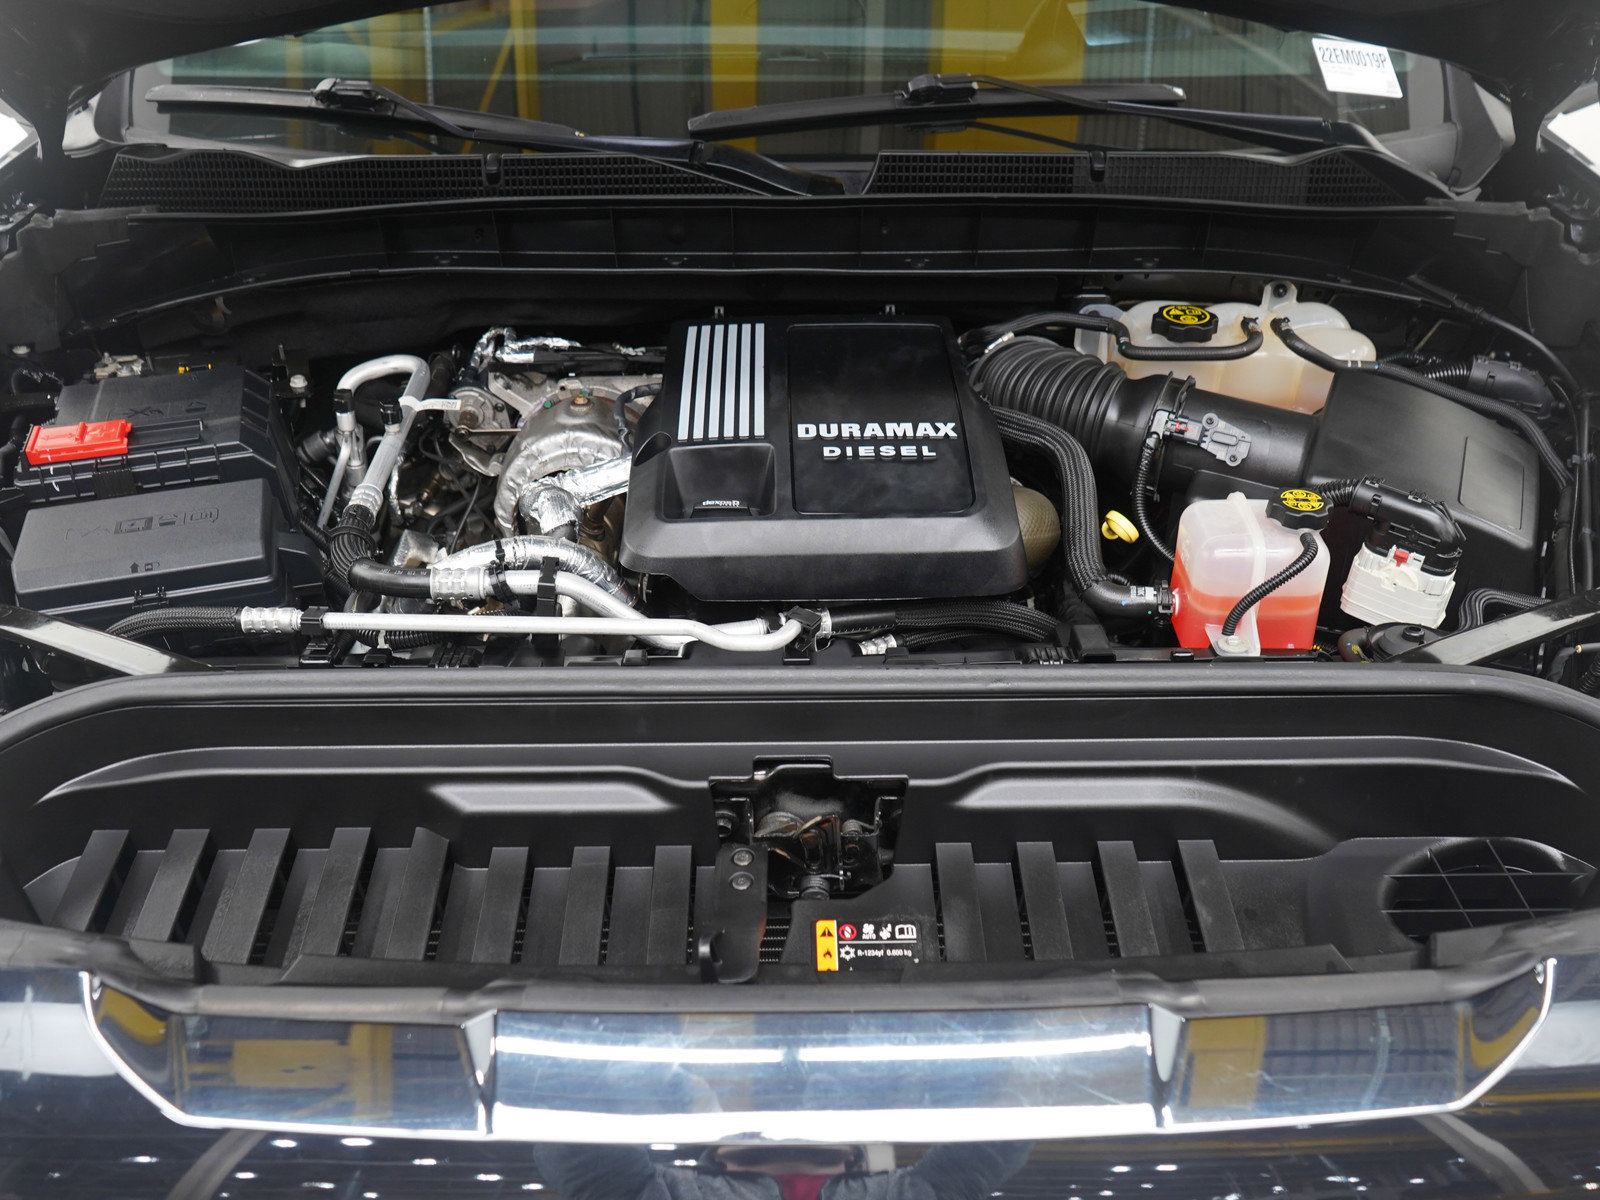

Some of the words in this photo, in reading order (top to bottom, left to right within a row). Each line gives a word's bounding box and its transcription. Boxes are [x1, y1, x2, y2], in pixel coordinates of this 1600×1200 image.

[1318, 46, 1387, 68] 22EM0019P
[797, 422, 958, 440] DURAMAX
[822, 445, 937, 460] DIESEL
[904, 949, 912, 957] kg
